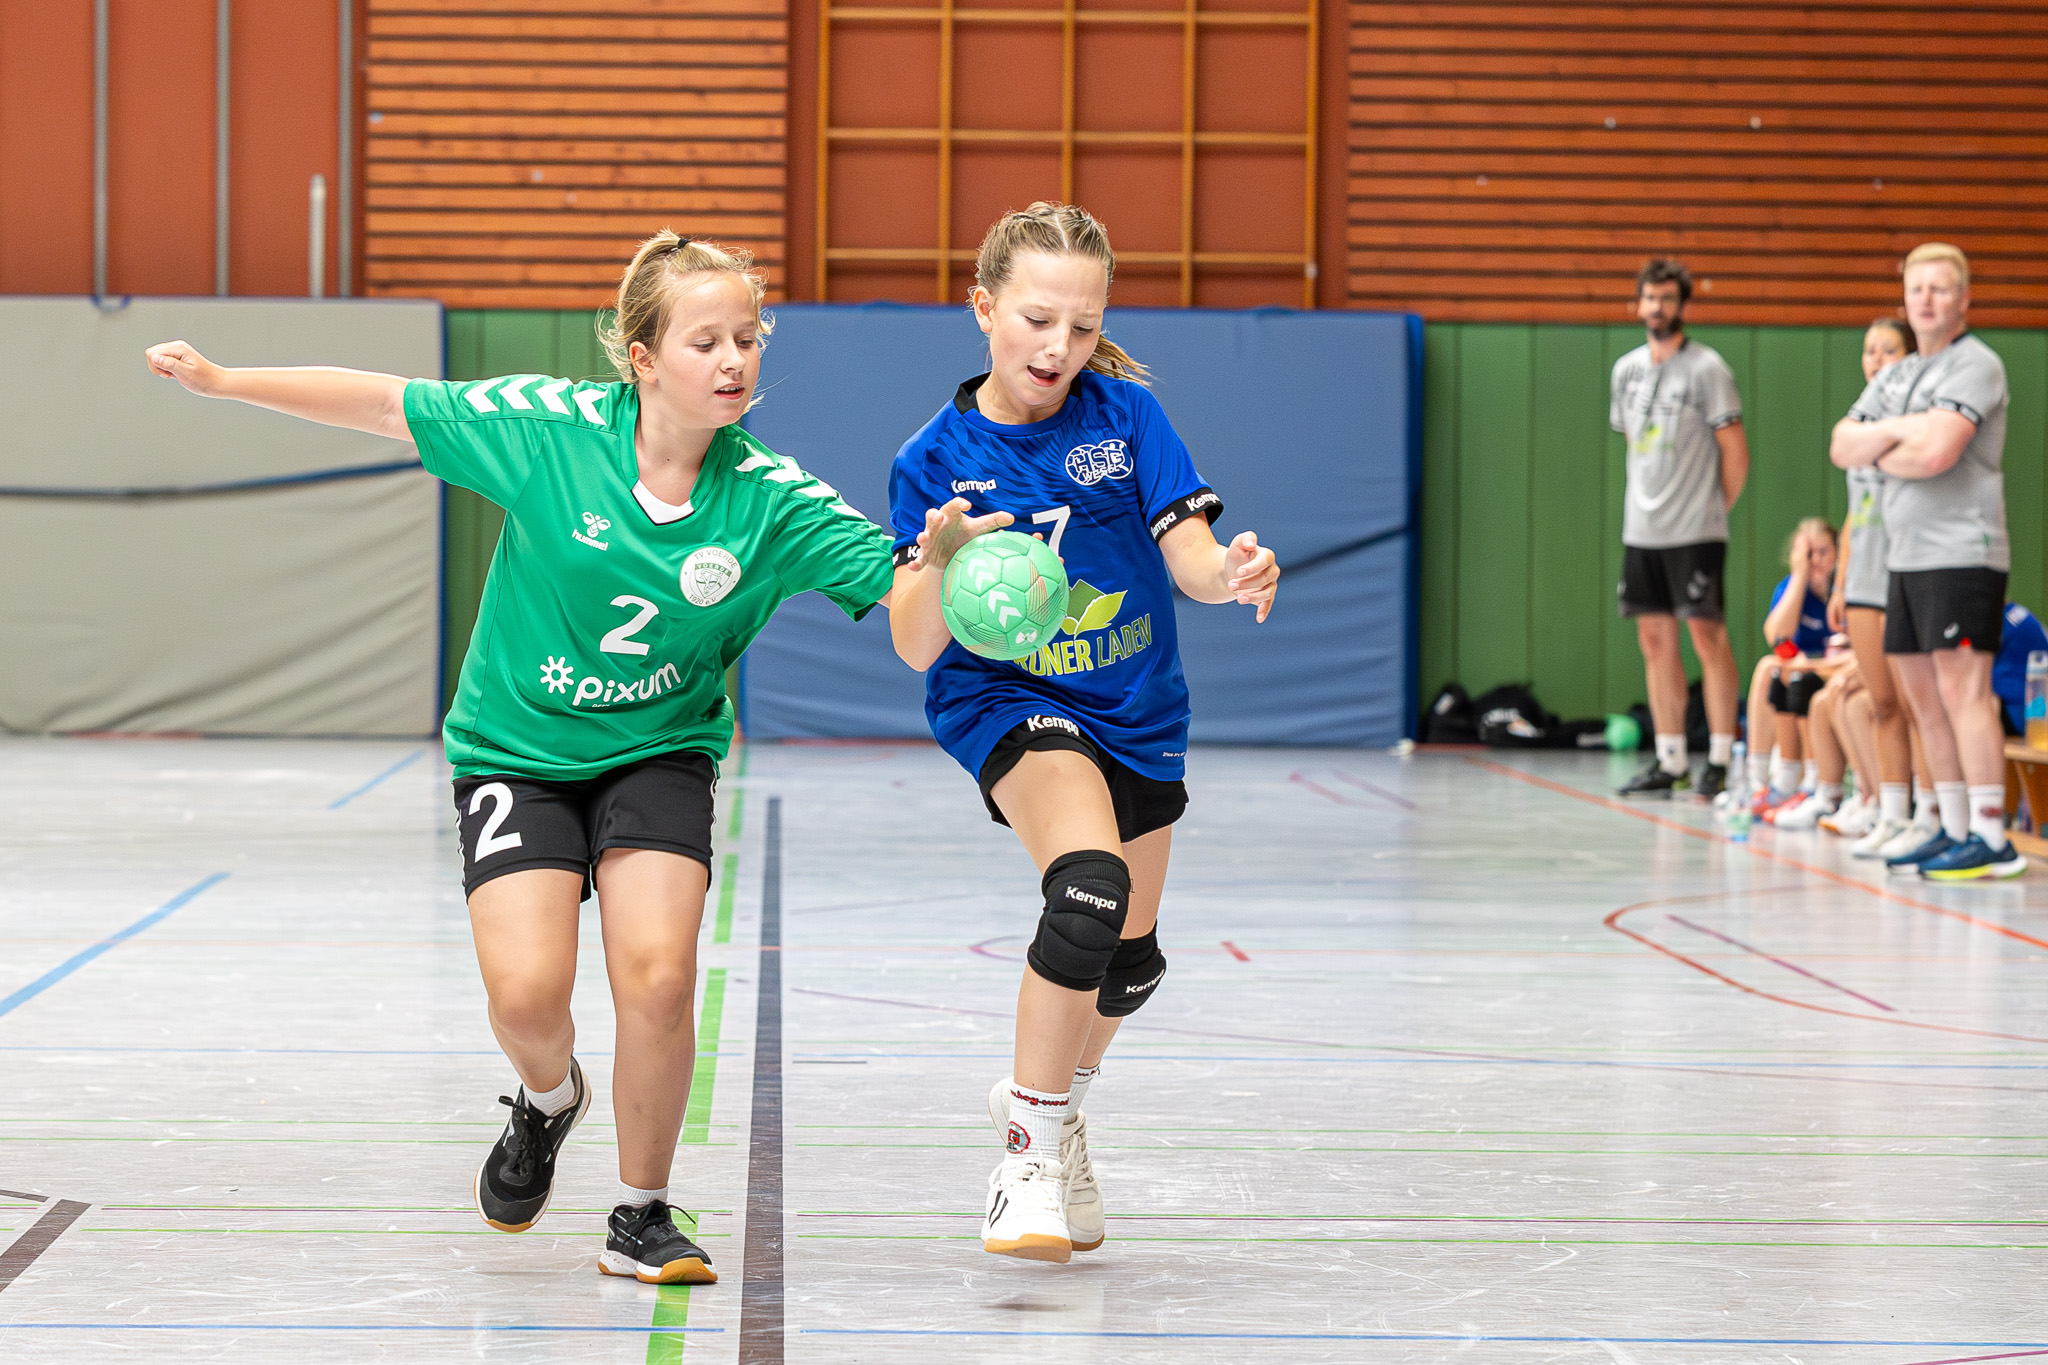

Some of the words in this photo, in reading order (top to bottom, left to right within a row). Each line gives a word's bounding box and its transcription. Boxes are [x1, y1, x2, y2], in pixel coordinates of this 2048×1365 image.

[1185, 493, 1220, 512] Kemp
[571, 528, 609, 551] hummel
[1031, 504, 1071, 557] 7
[694, 551, 704, 560] TV
[706, 549, 738, 569] VOERDE
[689, 594, 704, 605] 1920
[599, 594, 660, 656] 2
[1096, 612, 1152, 669] LADEN
[572, 662, 681, 706] pixum
[1026, 714, 1080, 737] Kempa
[468, 782, 523, 863] 2
[1065, 885, 1118, 911] Kempa
